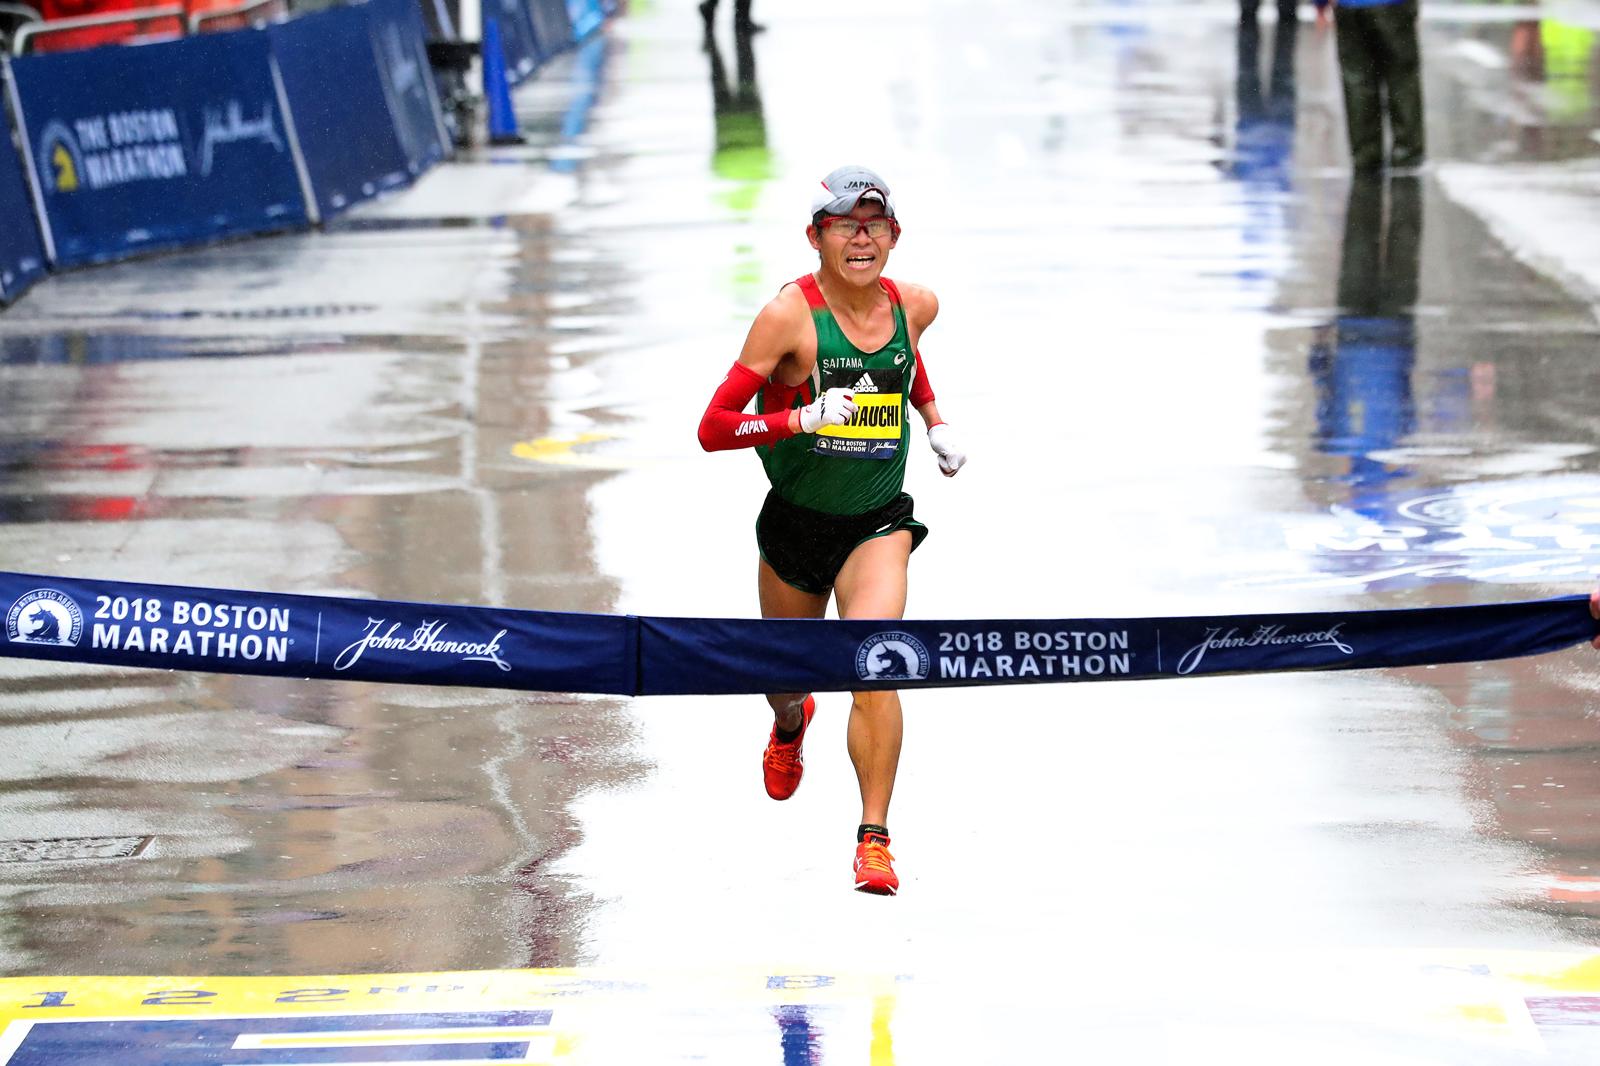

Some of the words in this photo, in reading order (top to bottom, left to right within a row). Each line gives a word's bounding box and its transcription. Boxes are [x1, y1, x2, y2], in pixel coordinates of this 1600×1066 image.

[75, 118, 109, 147] THE
[108, 111, 178, 145] BOSTON
[85, 145, 187, 189] MARATHON
[822, 357, 863, 369] SAITAMA
[852, 384, 879, 393] adidas
[735, 419, 768, 436] JAPAN
[844, 405, 899, 427] WAUCHI
[831, 444, 867, 453] MARATHON
[832, 439, 845, 447] 2018
[846, 440, 867, 448] BOSTON
[8, 606, 20, 637] BOSTON
[18, 590, 57, 608] ATHLETIC
[94, 595, 162, 622] 2018
[172, 601, 290, 632] BOSTON
[91, 623, 288, 662] MARATHON
[333, 616, 406, 671] John
[405, 619, 512, 672] Hancock
[865, 634, 900, 650] ATHLETIC
[939, 631, 1003, 652] 2018
[1014, 631, 1129, 651] BOSTON
[1177, 626, 1246, 675] John
[1245, 622, 1354, 654] Hancock
[940, 653, 1130, 679] MARATHON
